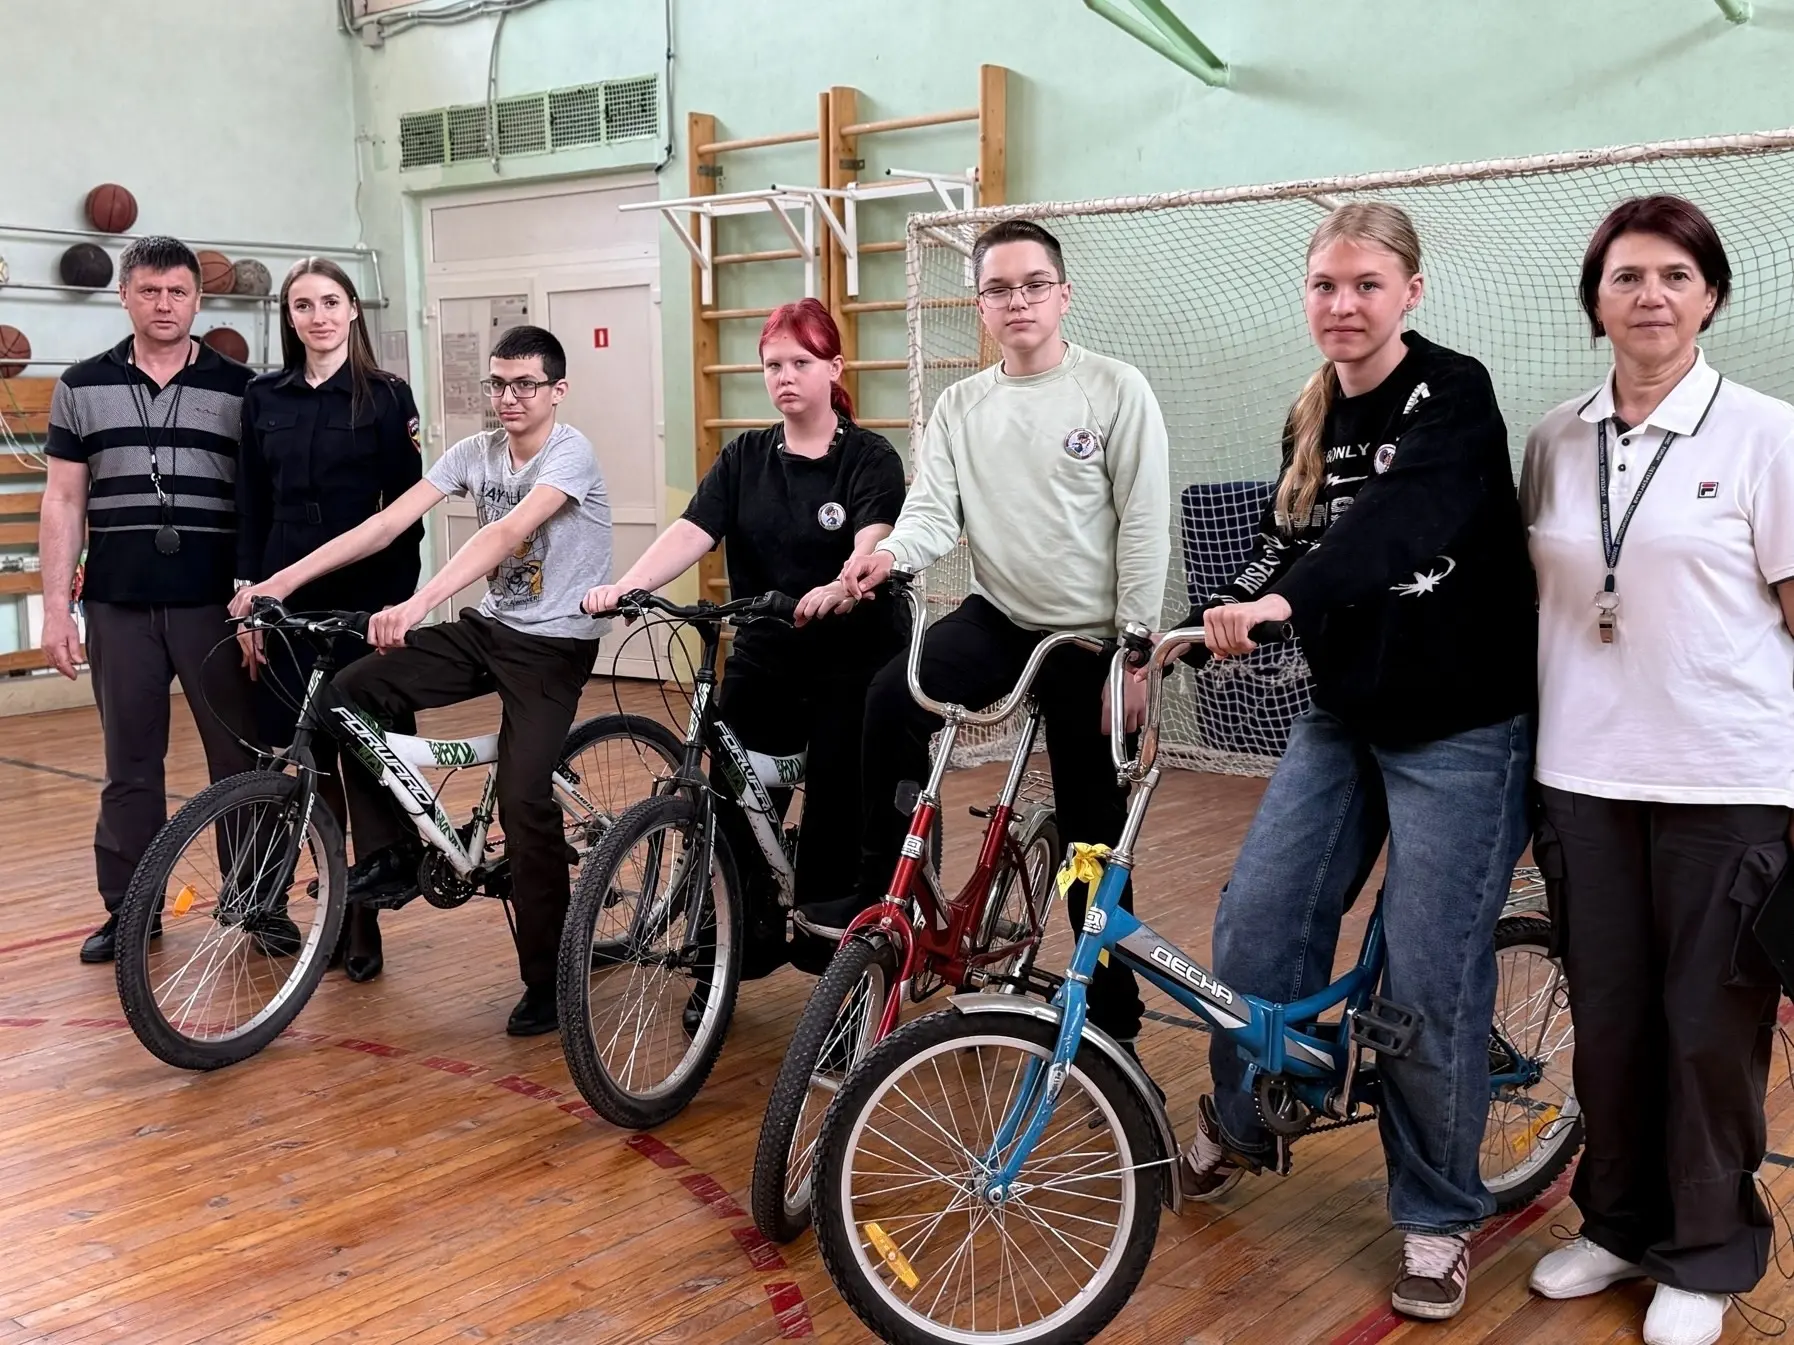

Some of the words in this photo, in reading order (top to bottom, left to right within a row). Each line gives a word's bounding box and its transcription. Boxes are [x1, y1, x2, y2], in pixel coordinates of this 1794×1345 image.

[330, 706, 433, 806] FORWARD
[713, 720, 778, 824] FORWARD
[299, 792, 315, 849] FORWARD
[1150, 946, 1234, 1006] ДЕСНА
